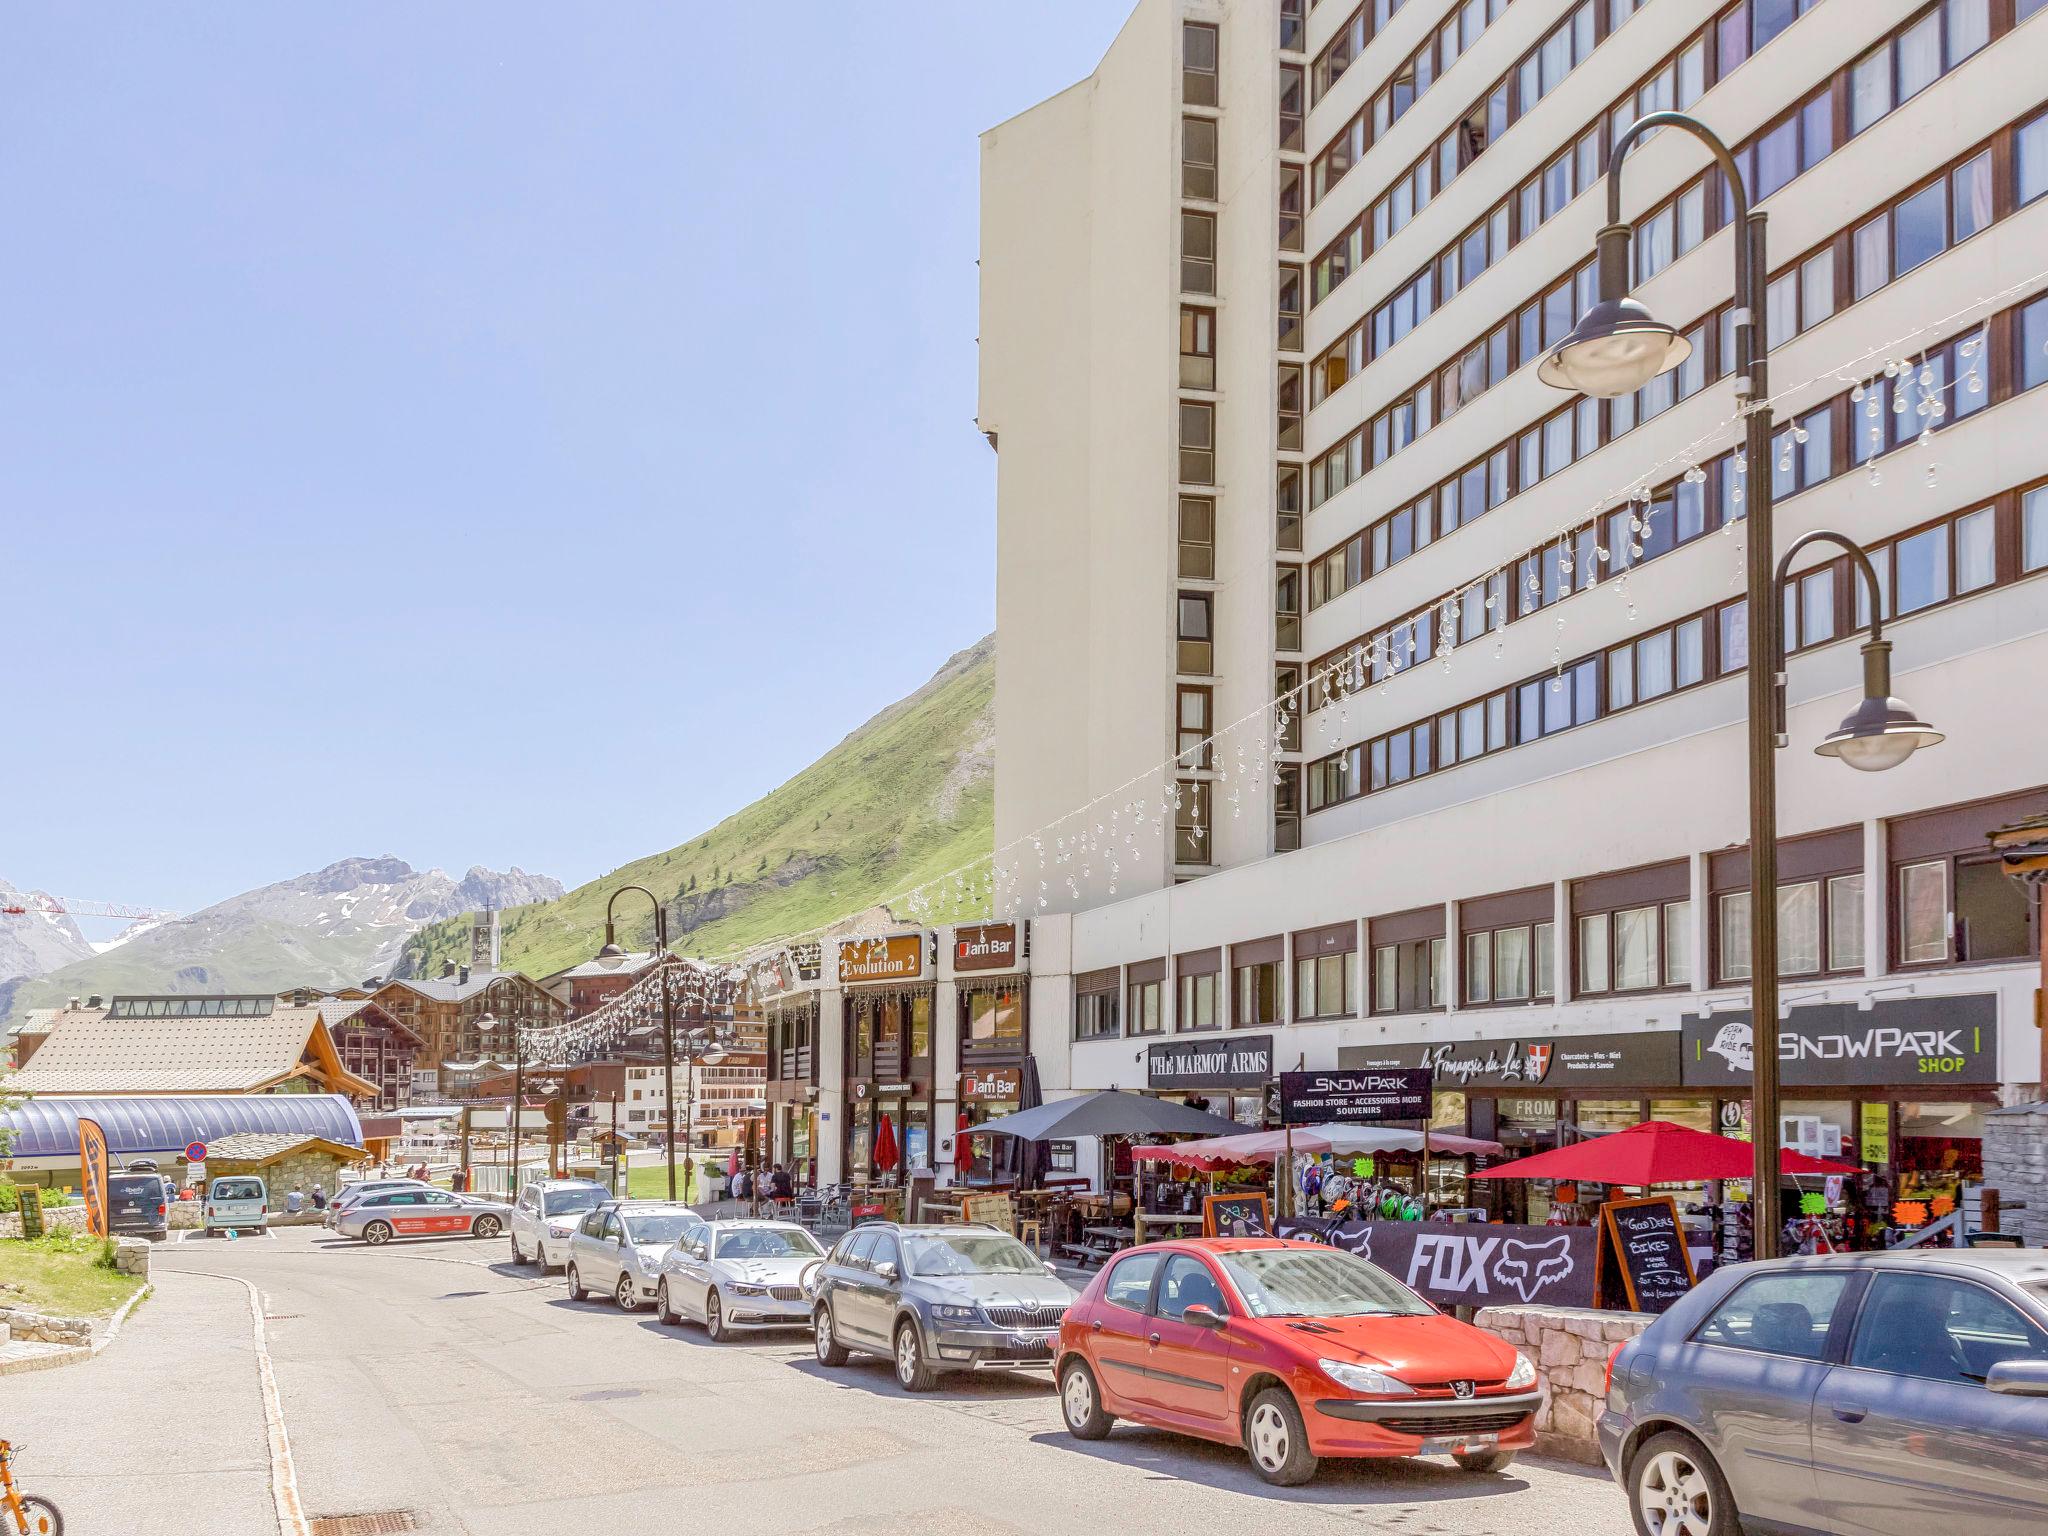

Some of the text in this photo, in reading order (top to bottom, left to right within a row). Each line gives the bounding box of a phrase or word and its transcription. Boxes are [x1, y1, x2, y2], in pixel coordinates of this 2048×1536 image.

[991, 939, 1012, 954] Bar
[845, 954, 916, 977] Evolution 2
[1722, 1024, 1743, 1035] BORN
[1726, 1033, 1736, 1041] TO
[1719, 1040, 1738, 1052] RIDE
[1150, 1050, 1268, 1075] THE MARMOT ARMS
[1433, 1044, 1484, 1085] Fromagerie
[1485, 1051, 1500, 1073] du
[1500, 1042, 1522, 1081] Lac
[1918, 1057, 1966, 1074] SHOP
[996, 1079, 1016, 1094] Bar
[1293, 1100, 1324, 1108] FASHION
[1325, 1098, 1348, 1106] STORE
[1354, 1096, 1400, 1106] ACCESSOIRES
[1401, 1095, 1422, 1104] MODE
[1516, 1100, 1556, 1116] FROM
[1336, 1106, 1381, 1115] SOUVENIRS
[1628, 1240, 1670, 1255] BIKES
[1406, 1233, 1501, 1294] FOX
